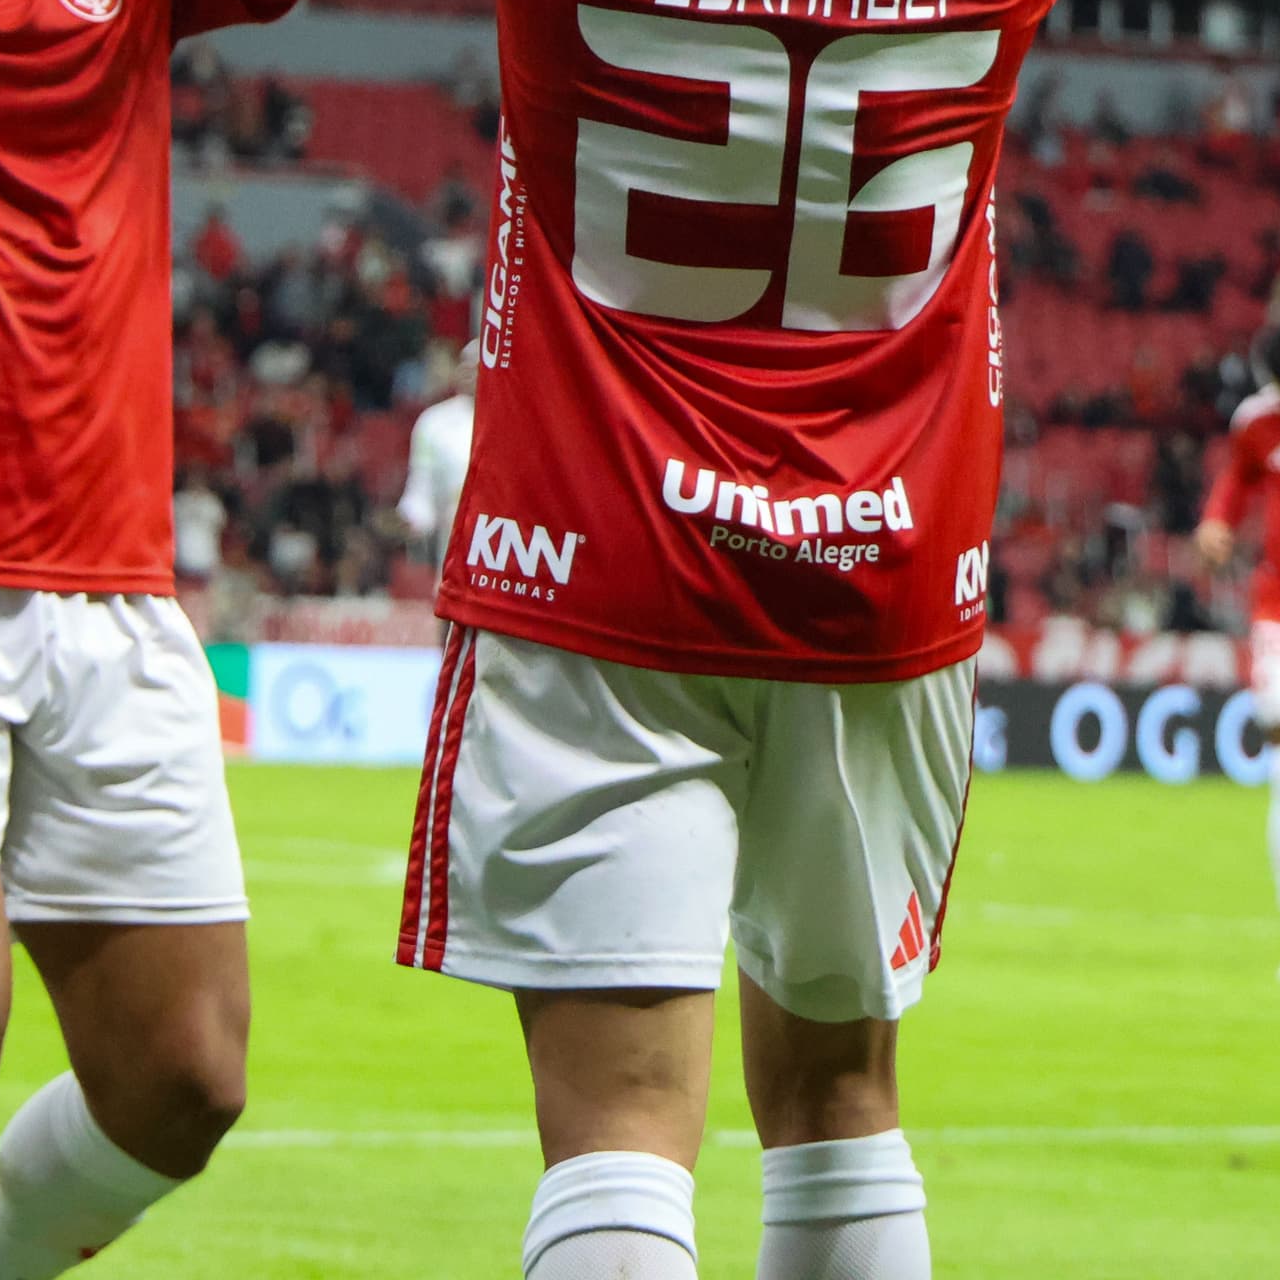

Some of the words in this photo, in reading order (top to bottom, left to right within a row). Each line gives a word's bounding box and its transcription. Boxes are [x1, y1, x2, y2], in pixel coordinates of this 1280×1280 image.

[571, 3, 1001, 331] 26
[662, 458, 914, 536] Unimed
[466, 513, 578, 585] KNN
[710, 525, 788, 561] Porto
[794, 538, 880, 572] Alegre
[470, 573, 556, 602] IDIOMAS
